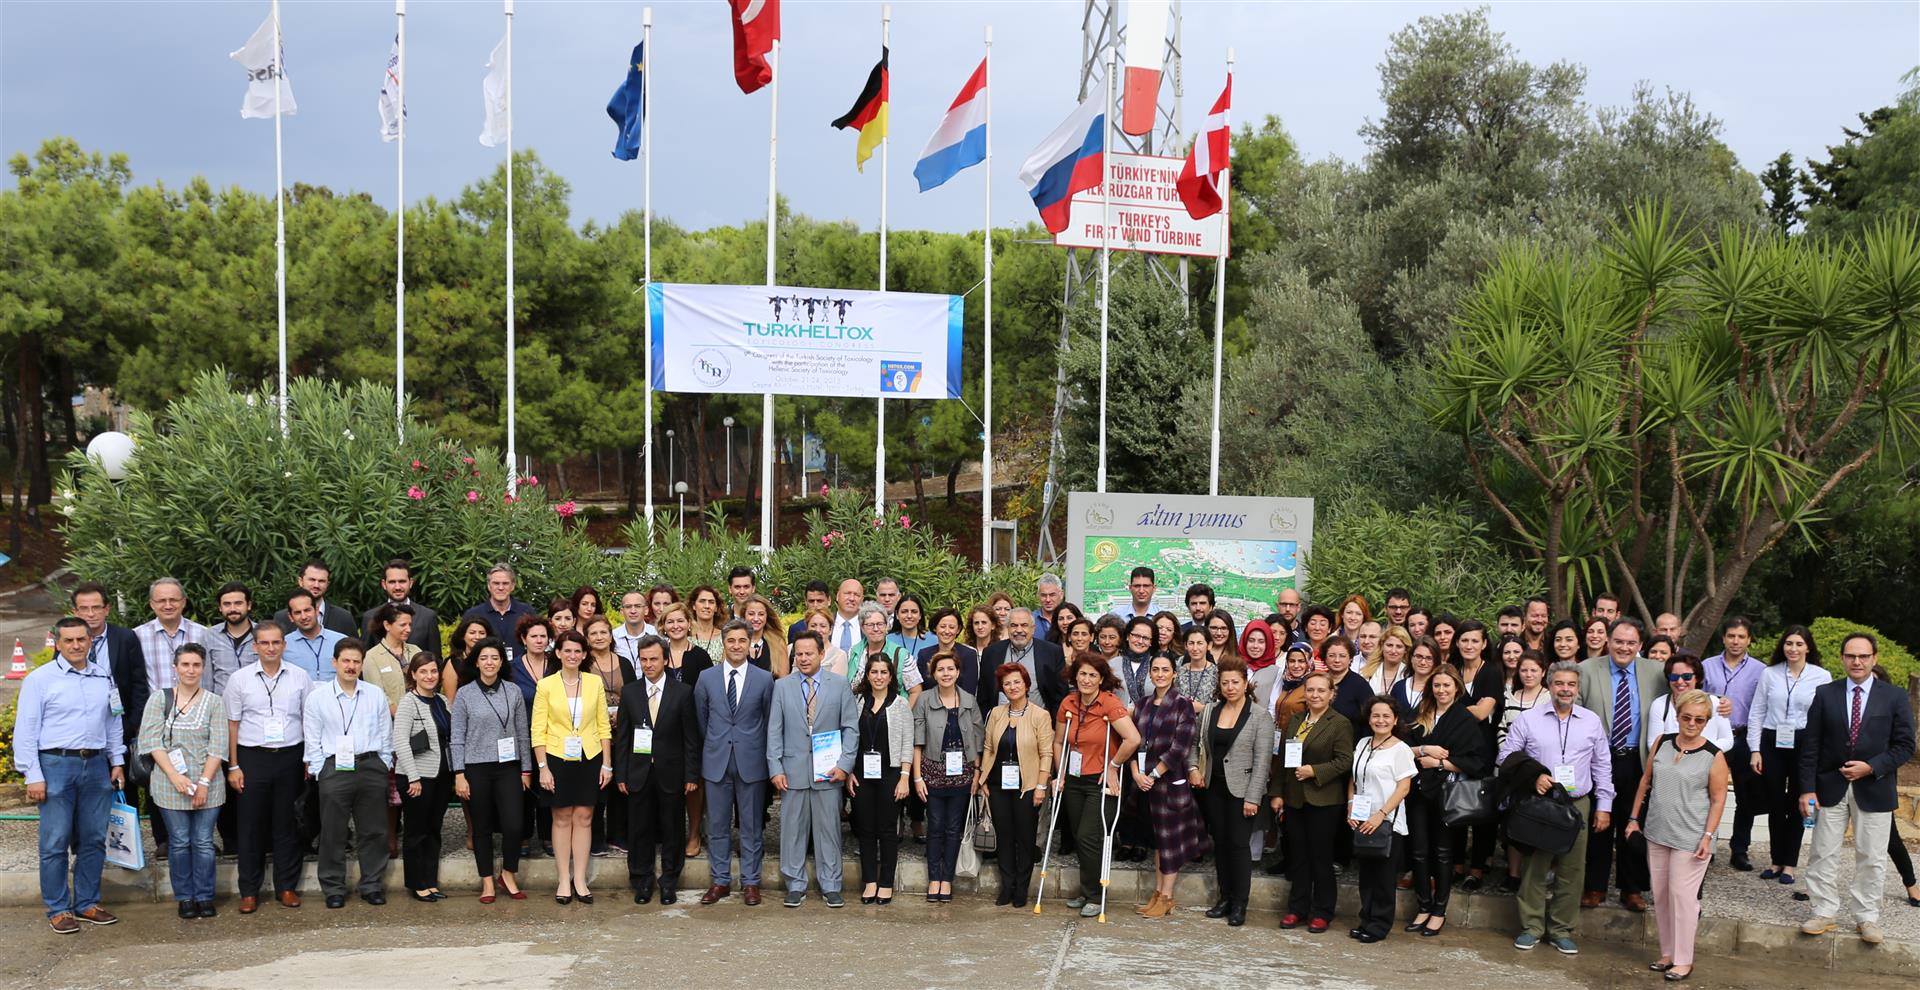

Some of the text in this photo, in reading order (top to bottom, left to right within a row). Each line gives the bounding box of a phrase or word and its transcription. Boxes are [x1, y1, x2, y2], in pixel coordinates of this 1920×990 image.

[1110, 163, 1179, 183] TÜRKİYE'NİN
[1109, 181, 1153, 200] RÜZGAR
[1156, 185, 1182, 201] TÜR
[1118, 212, 1171, 230] TURKEY'S
[1121, 227, 1151, 243] WIND
[1155, 231, 1202, 247] TURBINE
[743, 322, 874, 340] TURKHELTOX
[816, 354, 835, 362] Society
[844, 355, 873, 363] Toxicology
[791, 366, 810, 374] Society
[819, 367, 848, 376] Toxicology
